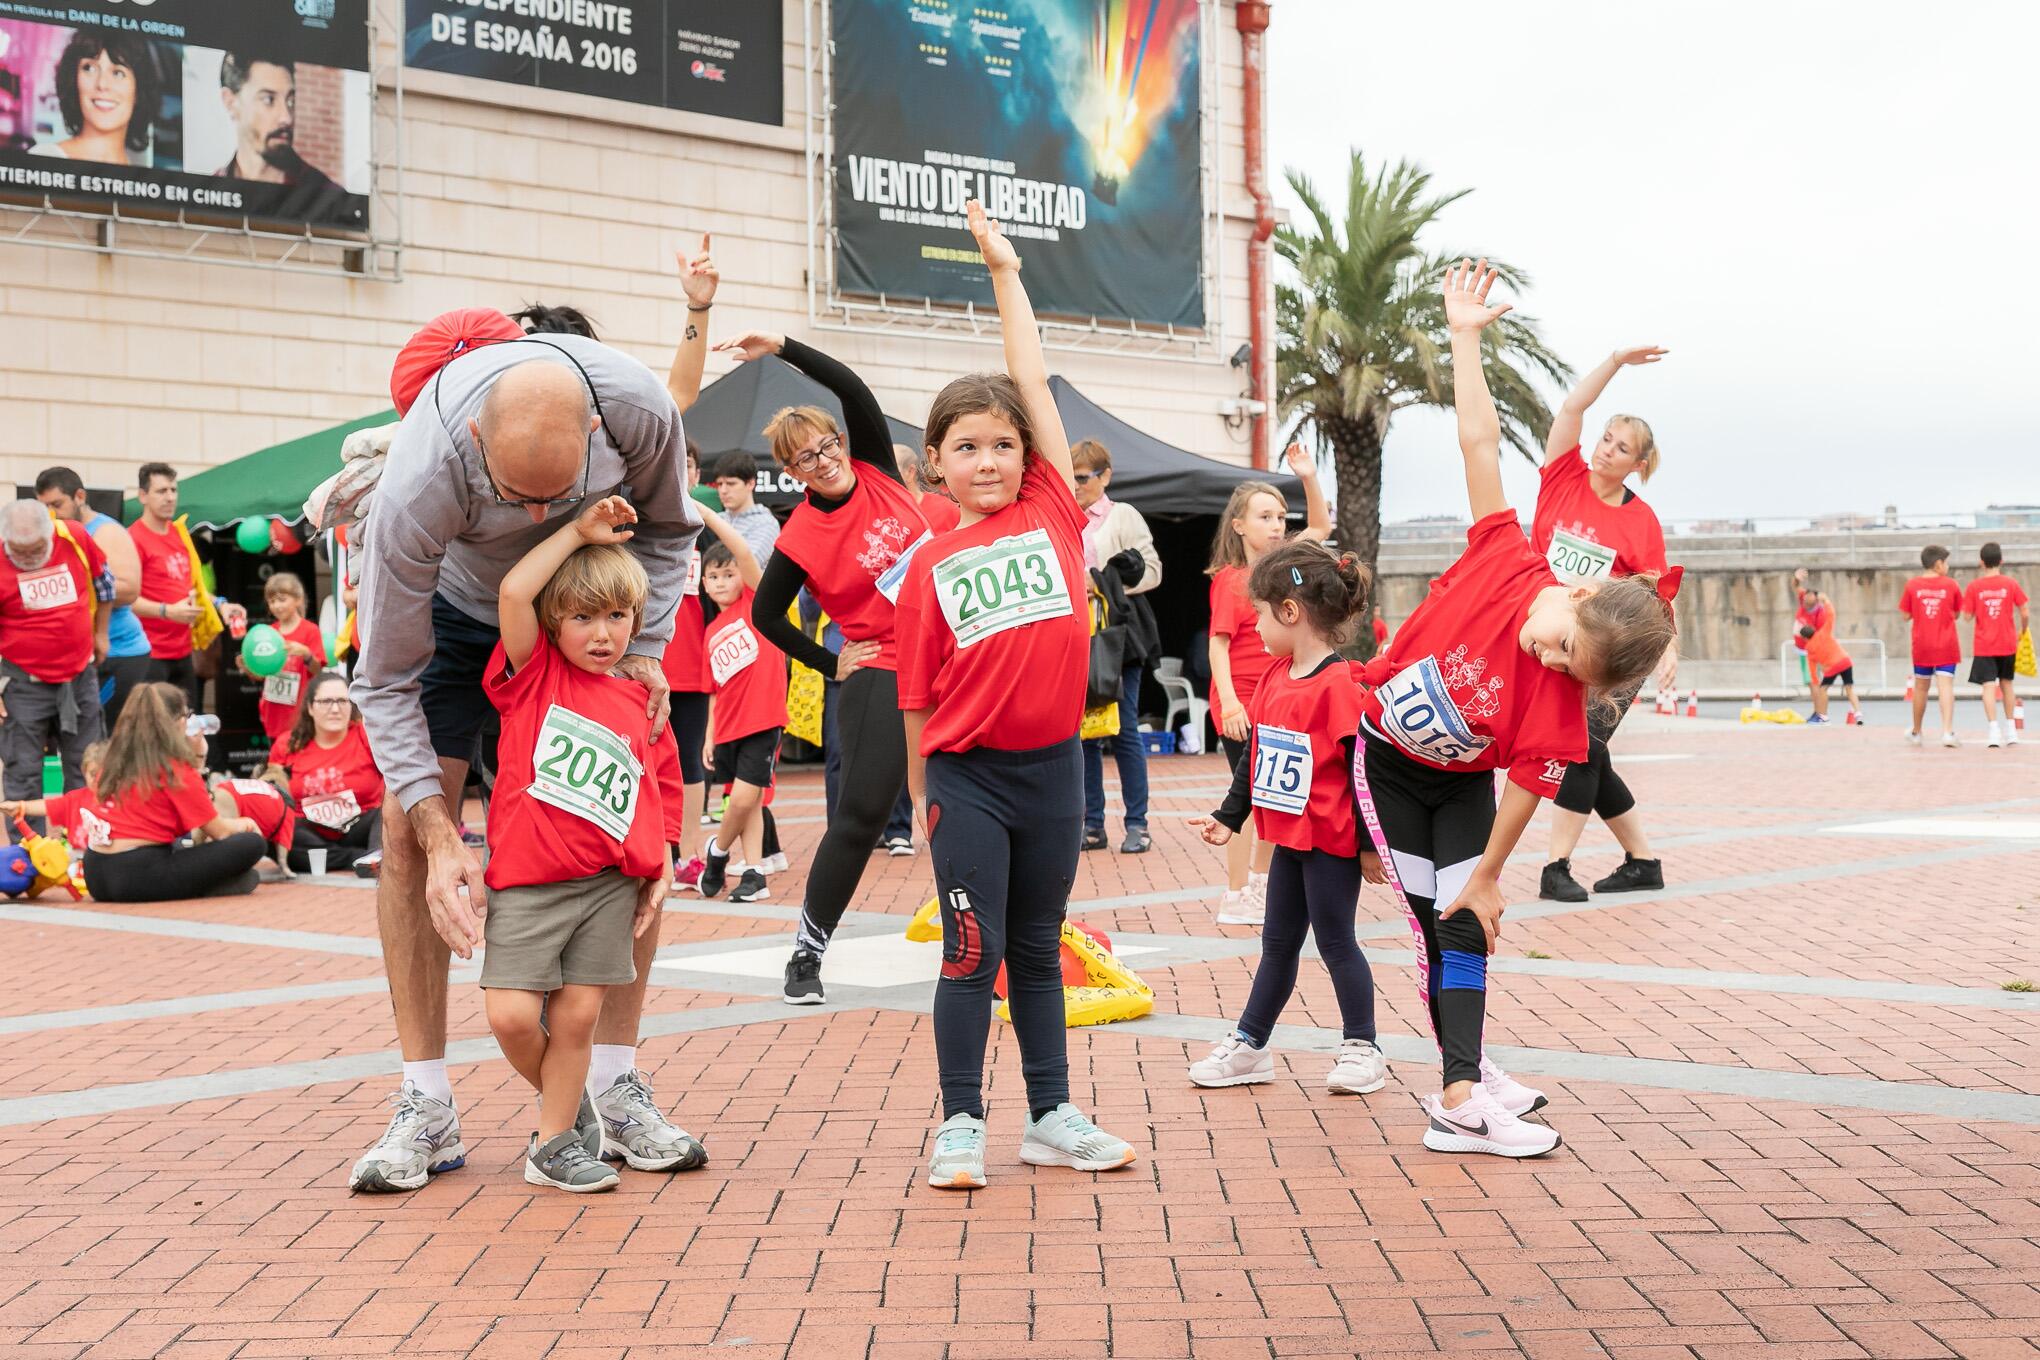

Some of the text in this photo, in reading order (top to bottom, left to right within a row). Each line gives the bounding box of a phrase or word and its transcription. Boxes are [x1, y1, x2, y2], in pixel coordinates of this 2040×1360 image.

[68, 9, 100, 25] DANI
[102, 14, 120, 28] DE
[121, 17, 139, 32] LA
[141, 20, 185, 38] ORDEN
[447, 0, 632, 35] ENDIENTE
[431, 12, 638, 75] DE ESPAÑA 2016
[80, 175, 161, 199] ESTRENO
[165, 184, 188, 201] EN
[192, 188, 243, 208] CINES
[848, 154, 1086, 230] VIENTO DE LIBERTAD
[1552, 546, 1606, 577] 2007
[27, 576, 68, 601] 3009
[952, 553, 1053, 621] 2043
[1394, 682, 1470, 759] 1015
[538, 734, 632, 815] 2043
